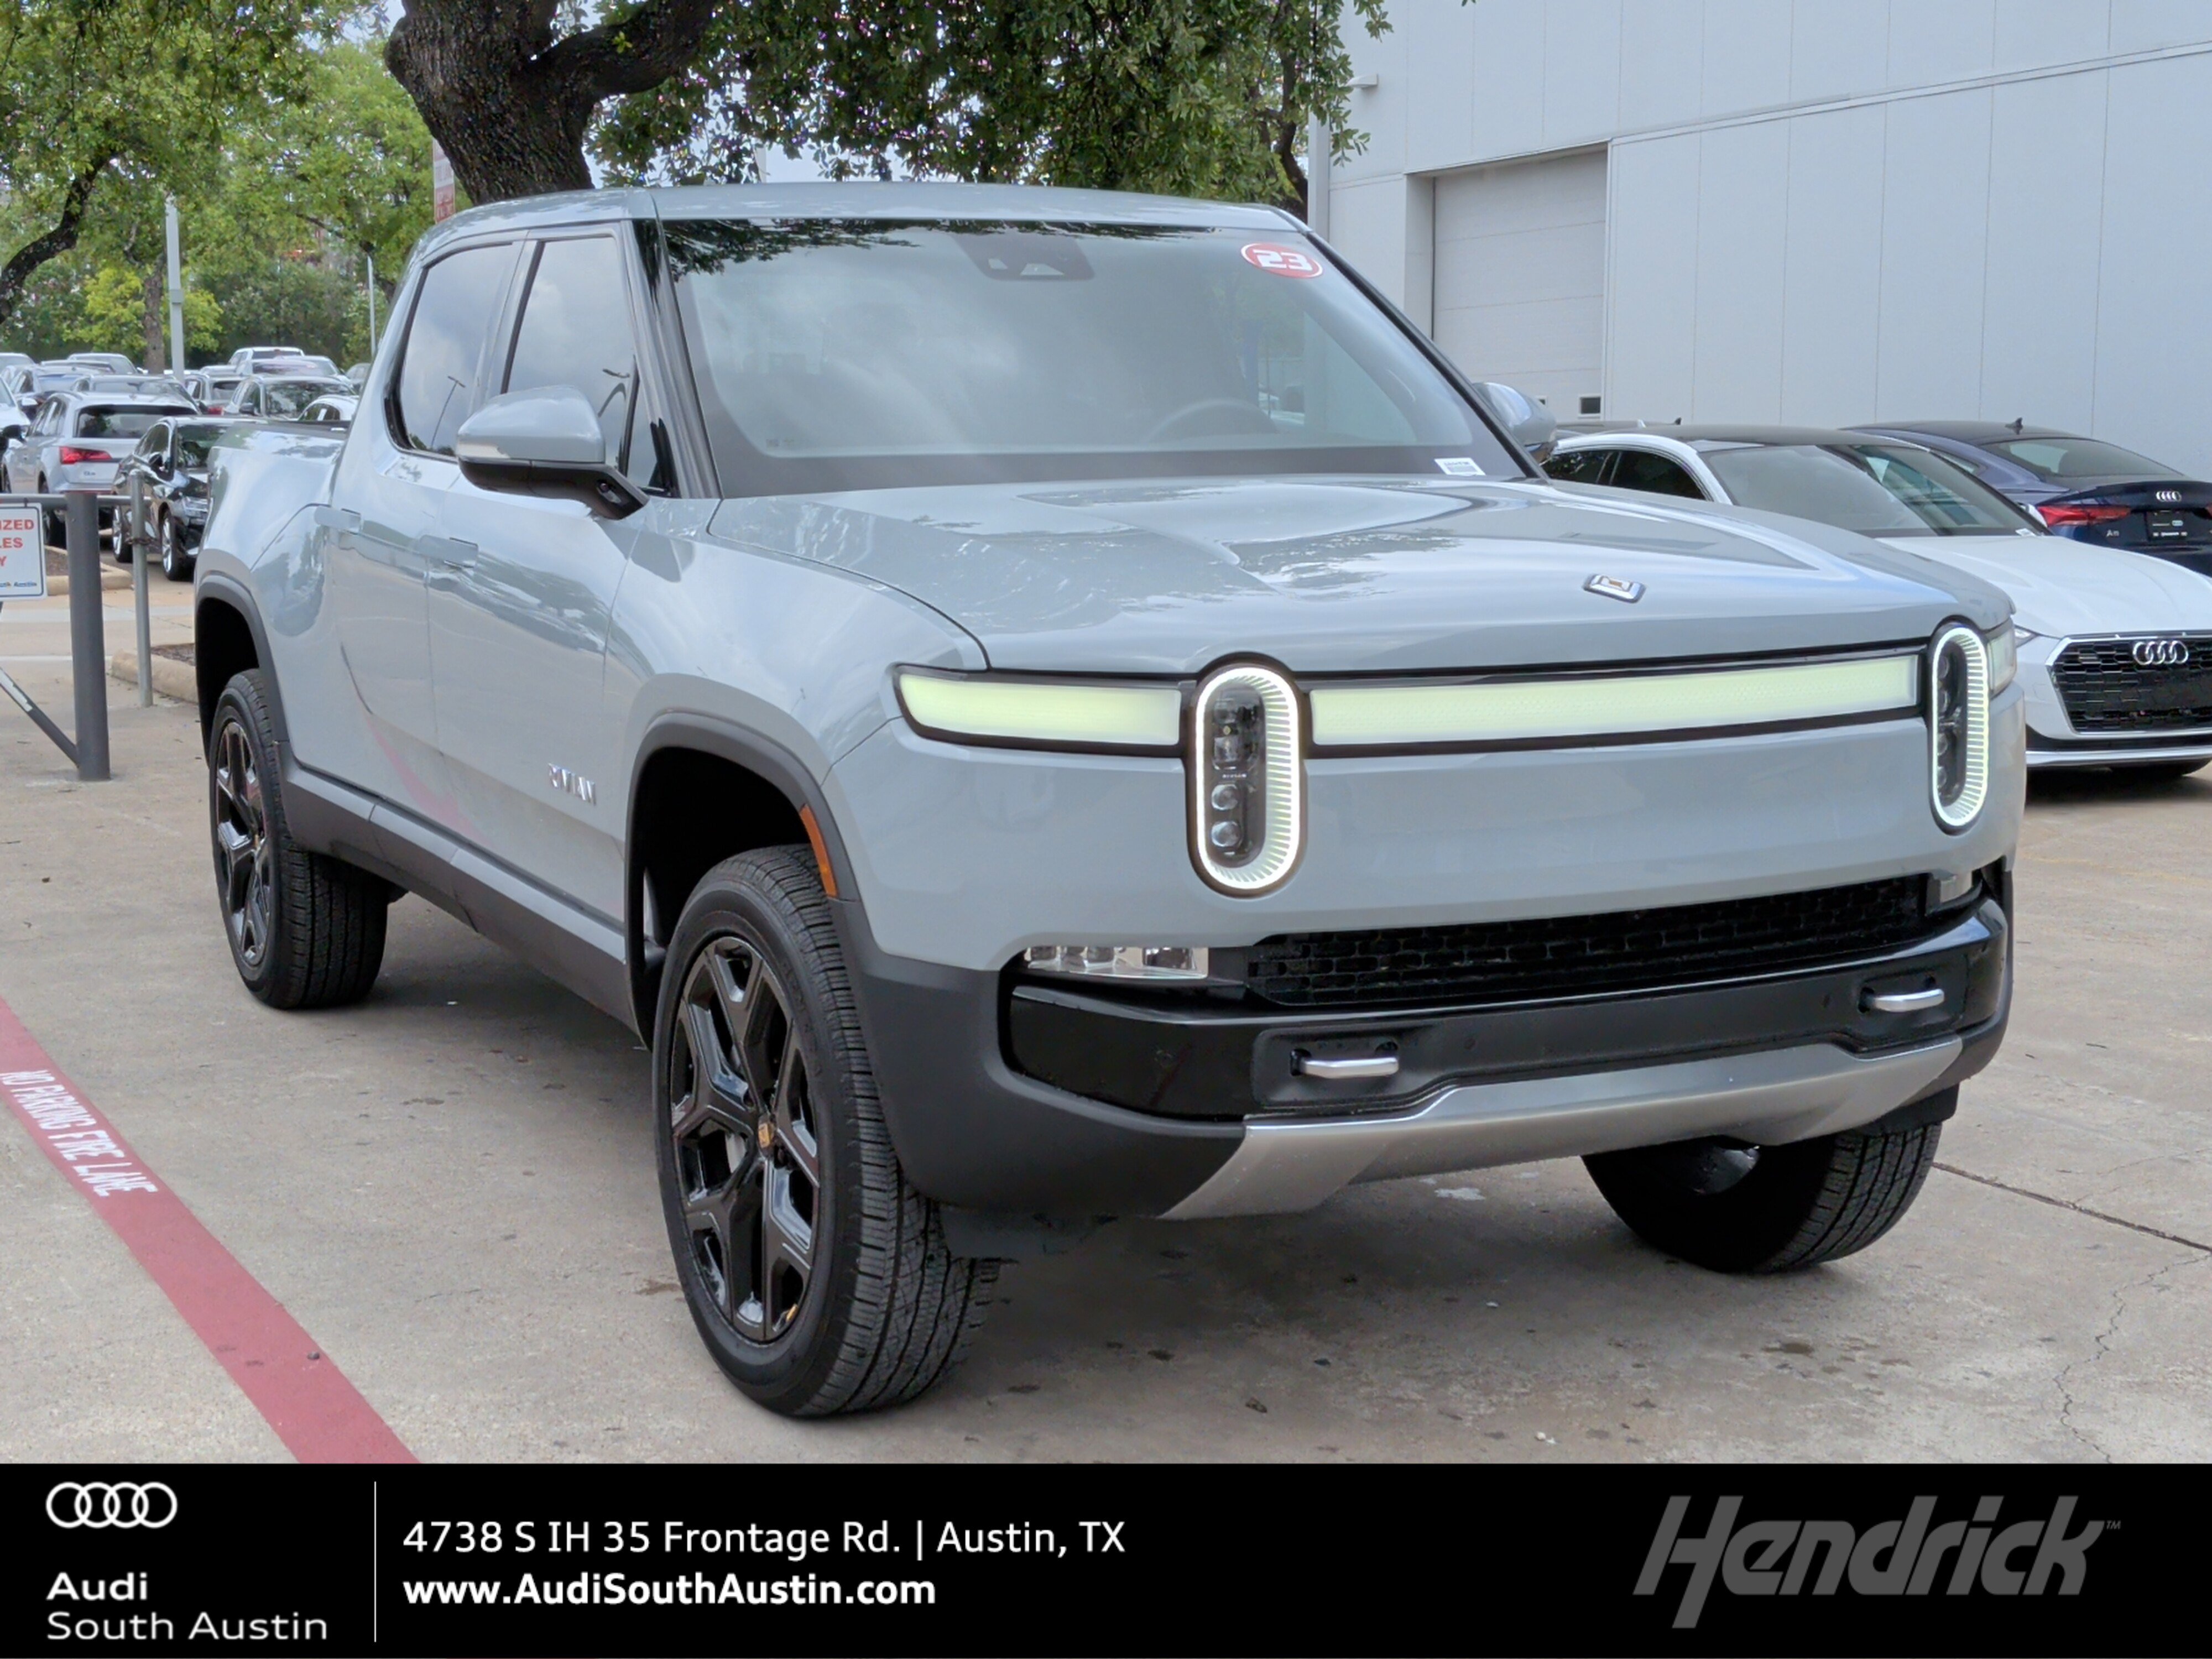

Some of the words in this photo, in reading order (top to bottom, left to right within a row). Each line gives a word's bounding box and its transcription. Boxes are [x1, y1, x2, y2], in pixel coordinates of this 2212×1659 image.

[1252, 249, 1313, 271] 23
[10, 1084, 97, 1130] PARKING
[48, 1130, 125, 1160] FIRE
[72, 1162, 159, 1196] LANE
